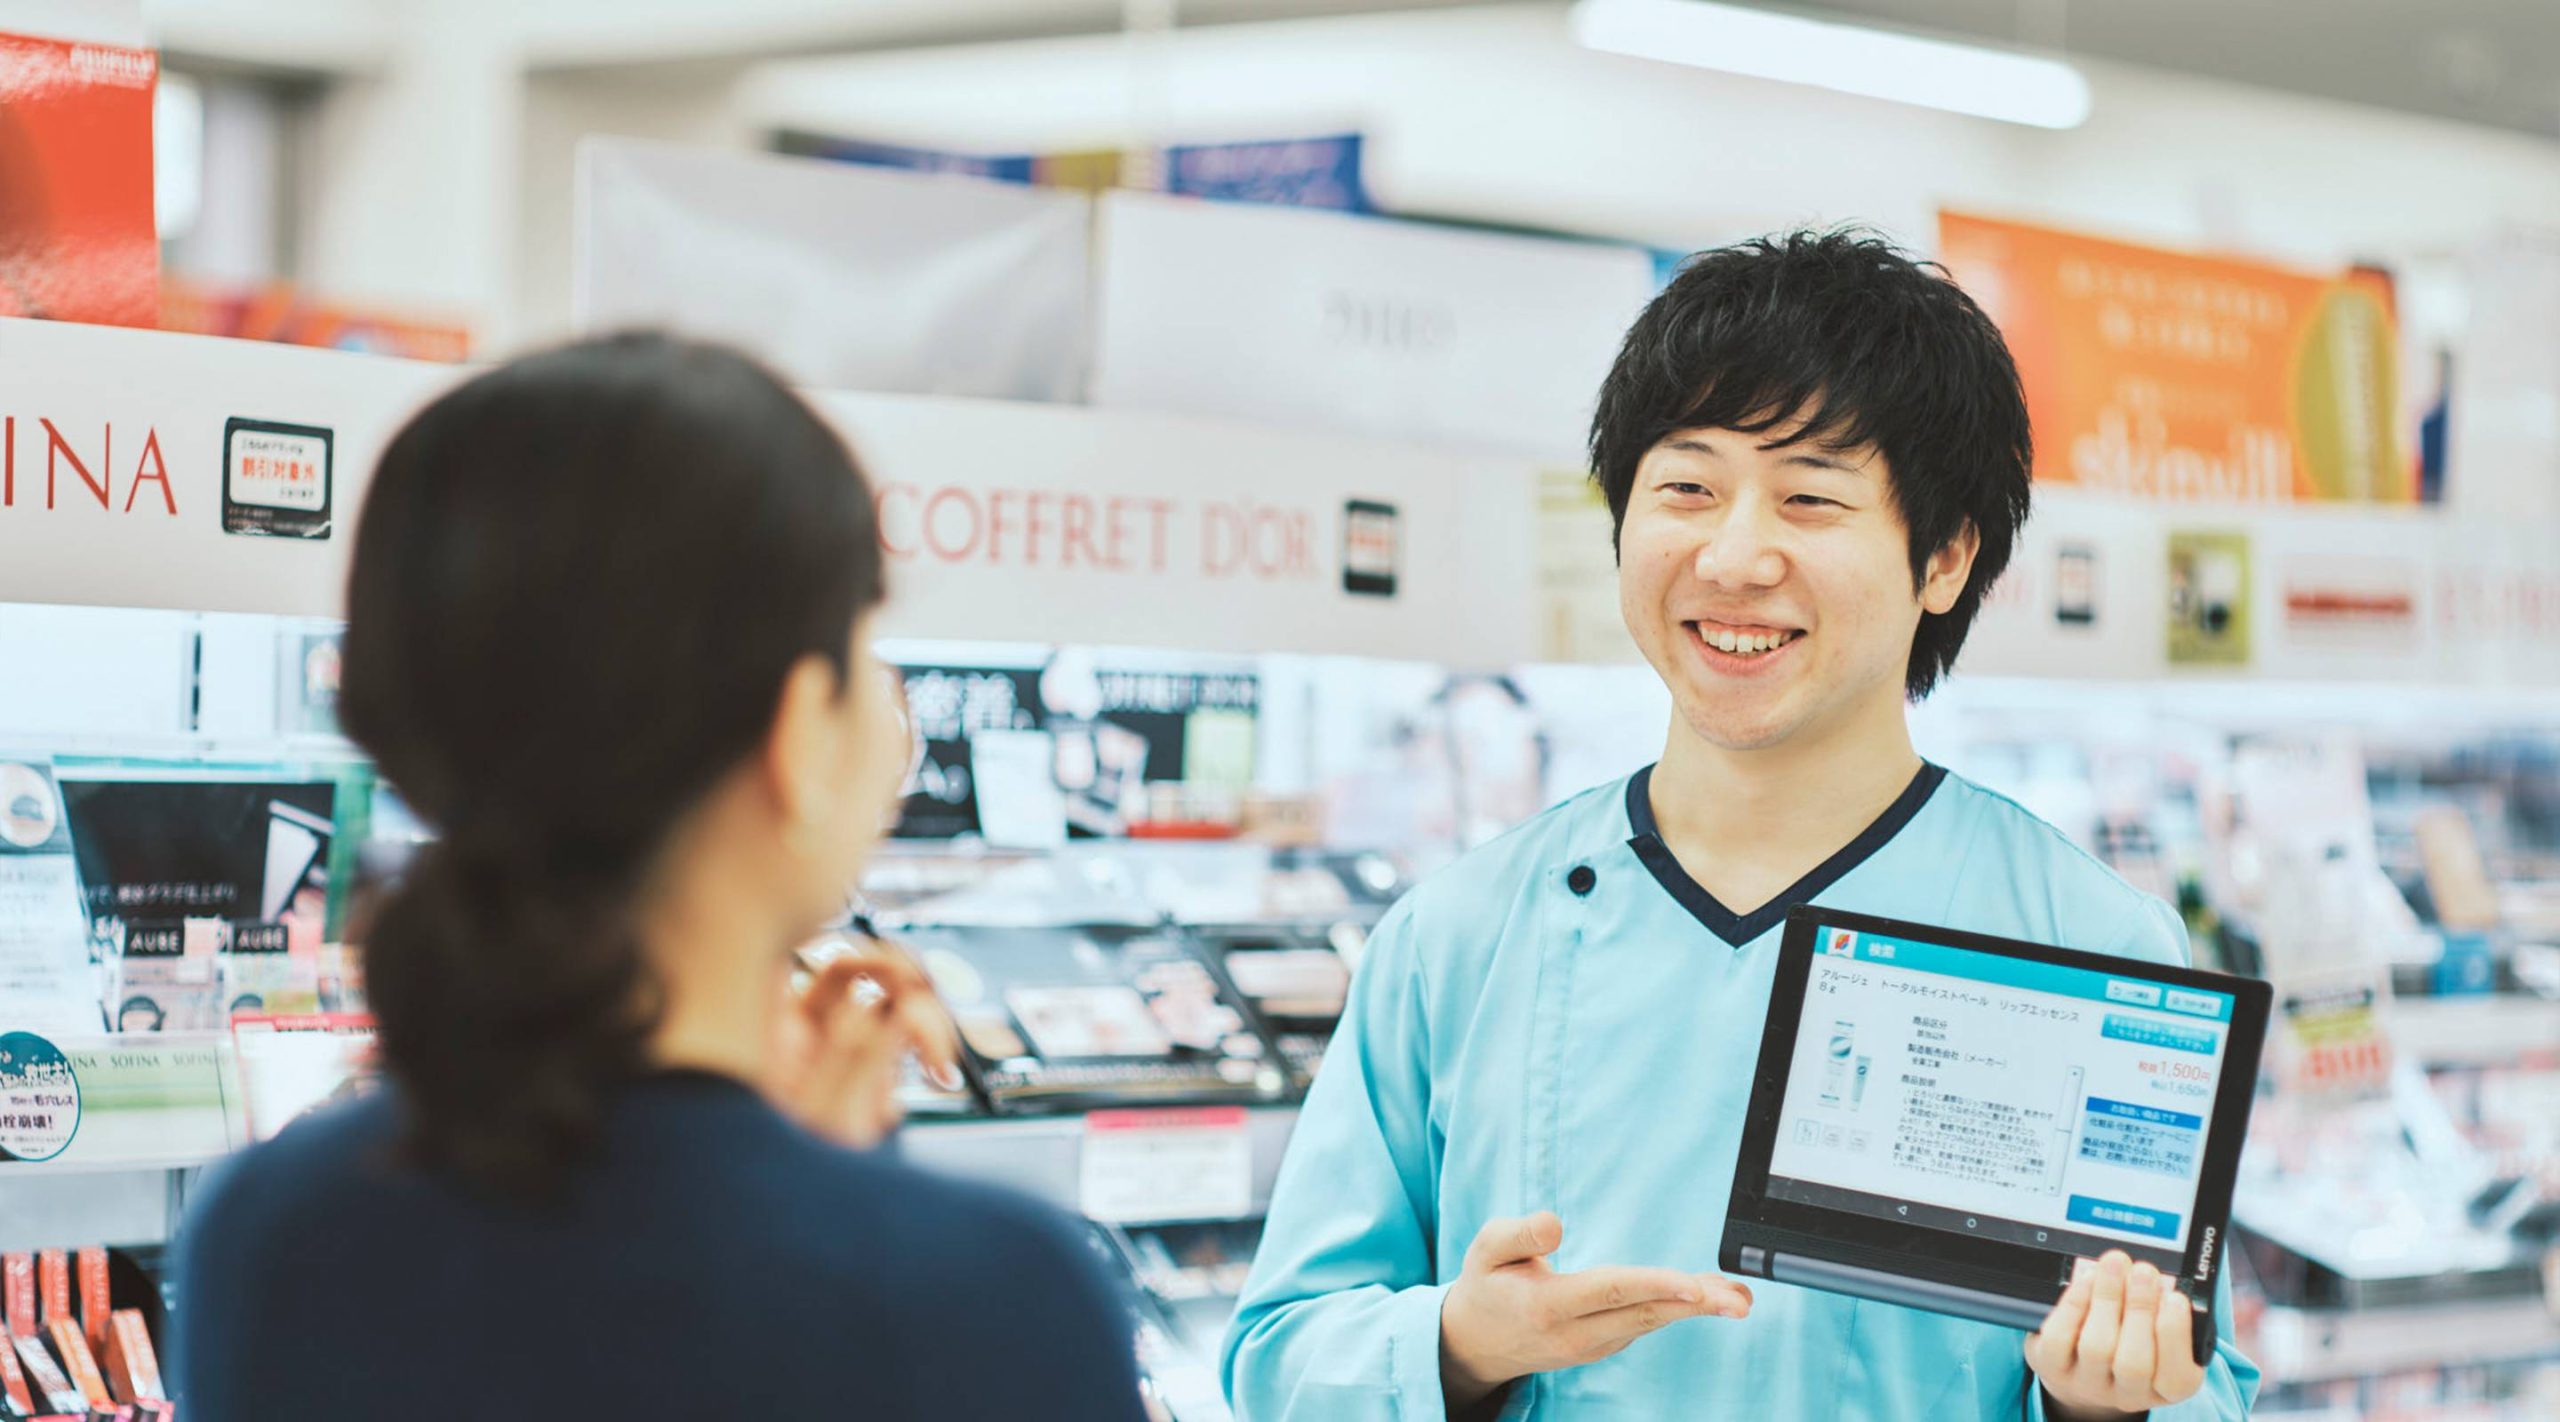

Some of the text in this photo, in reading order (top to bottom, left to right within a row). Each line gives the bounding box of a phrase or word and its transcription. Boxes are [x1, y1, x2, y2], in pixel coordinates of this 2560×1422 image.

[4, 416, 177, 515] INA
[242, 457, 316, 481] 割引対象外
[877, 482, 1176, 573] COFFRET
[1820, 968, 1869, 986] アルージェ
[1998, 998, 2081, 1023] リップエッセンス
[2193, 1226, 2217, 1281] Lenovo
